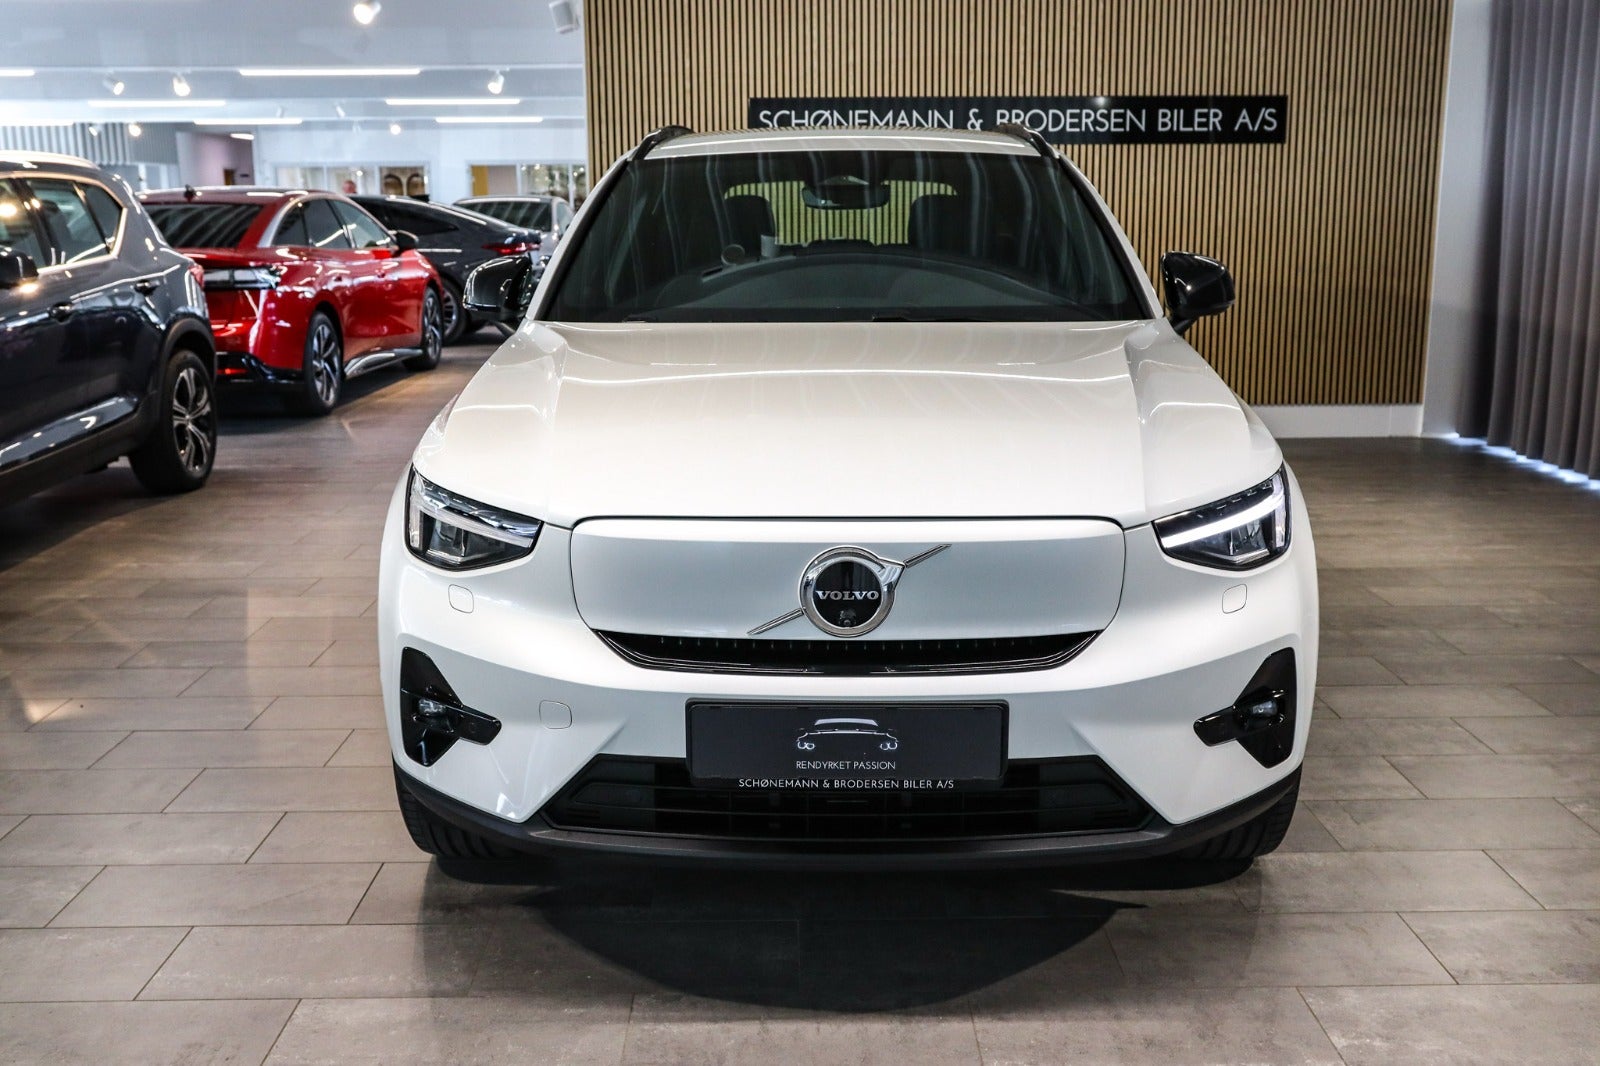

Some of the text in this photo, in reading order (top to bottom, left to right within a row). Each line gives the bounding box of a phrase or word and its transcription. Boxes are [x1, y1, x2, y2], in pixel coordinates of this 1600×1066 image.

[759, 107, 1278, 132] SCHØNEMANN & BRODERSEN BILER A/S
[815, 590, 879, 600] VOLVO
[796, 760, 896, 770] RENDYRKET PASSION
[738, 778, 955, 790] SCHØNEMANN & BRODERSEN BILER A/S
